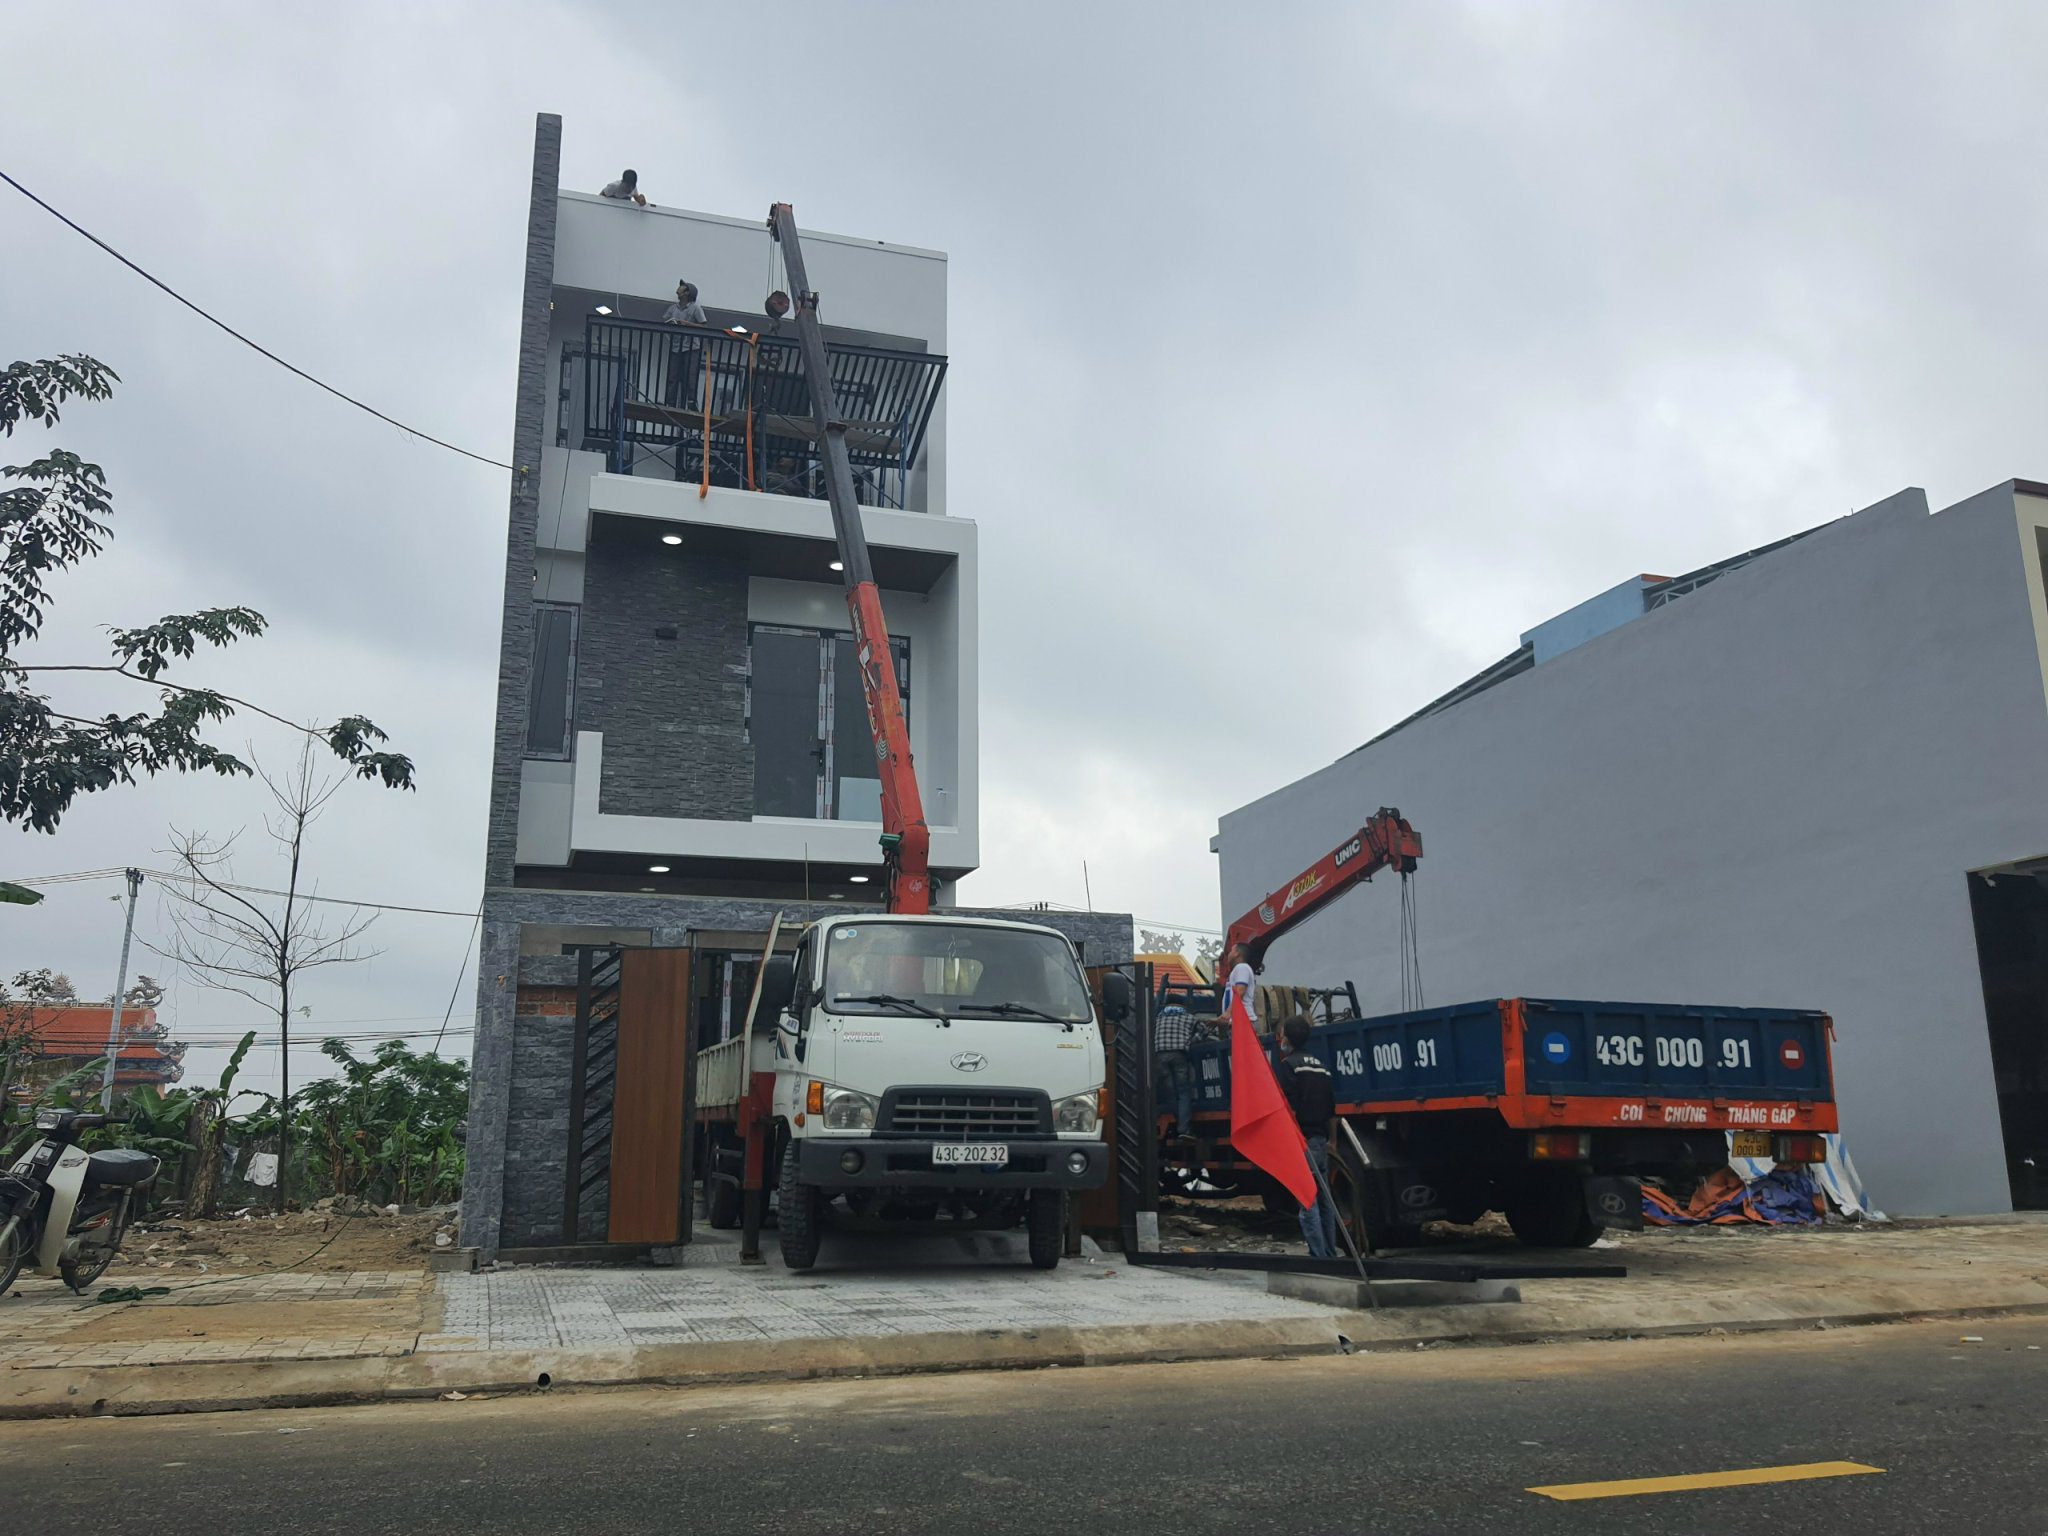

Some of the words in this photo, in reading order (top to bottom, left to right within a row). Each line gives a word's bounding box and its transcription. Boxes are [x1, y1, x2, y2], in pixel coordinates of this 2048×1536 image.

[1335, 839, 1360, 866] UNIC
[1336, 1048, 1364, 1075] 43C
[1373, 1042, 1402, 1072] 000
[1596, 1035, 1644, 1066] 43C
[1664, 1102, 1707, 1123] CHỪNG
[1771, 1103, 1796, 1124] GẤP
